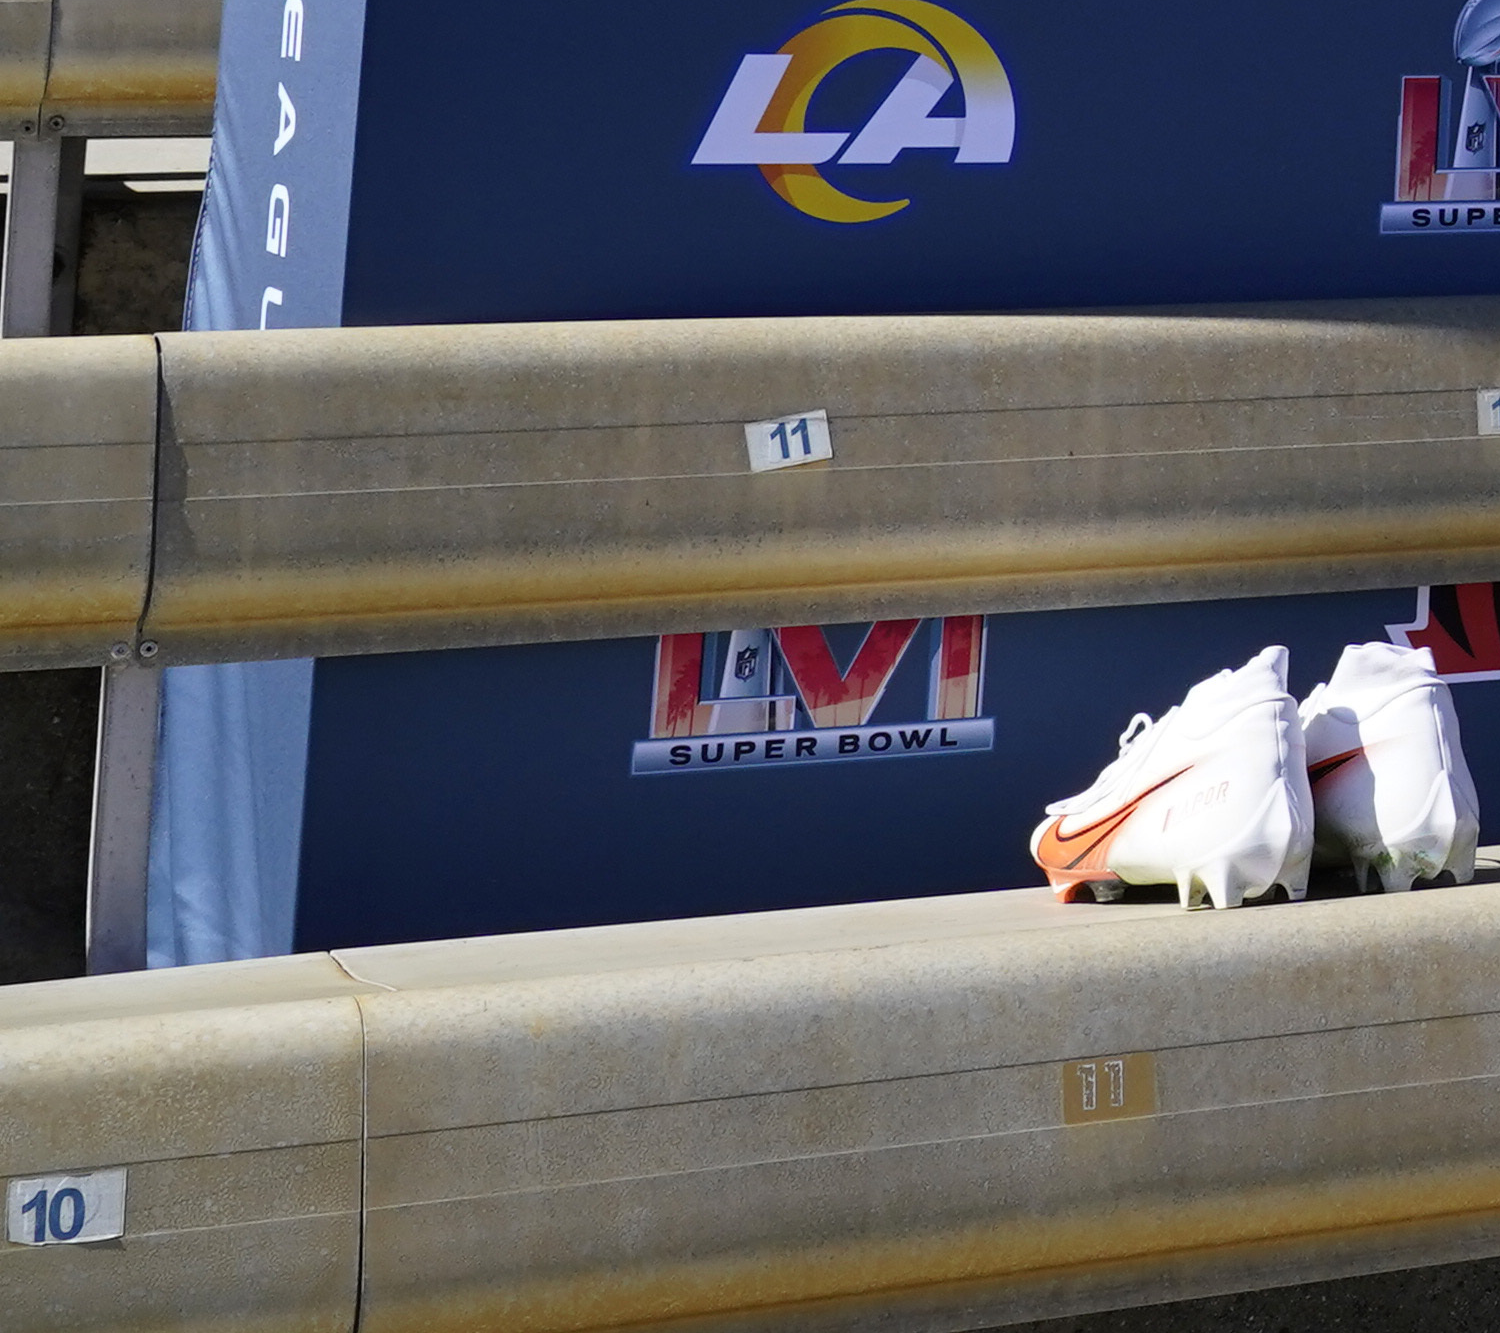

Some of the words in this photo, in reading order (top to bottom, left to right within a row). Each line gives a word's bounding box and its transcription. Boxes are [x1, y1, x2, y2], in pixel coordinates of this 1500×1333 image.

[770, 419, 811, 459] 11
[668, 735, 819, 765] SUPER
[838, 725, 959, 755] BOWL
[22, 1188, 85, 1237] 10
